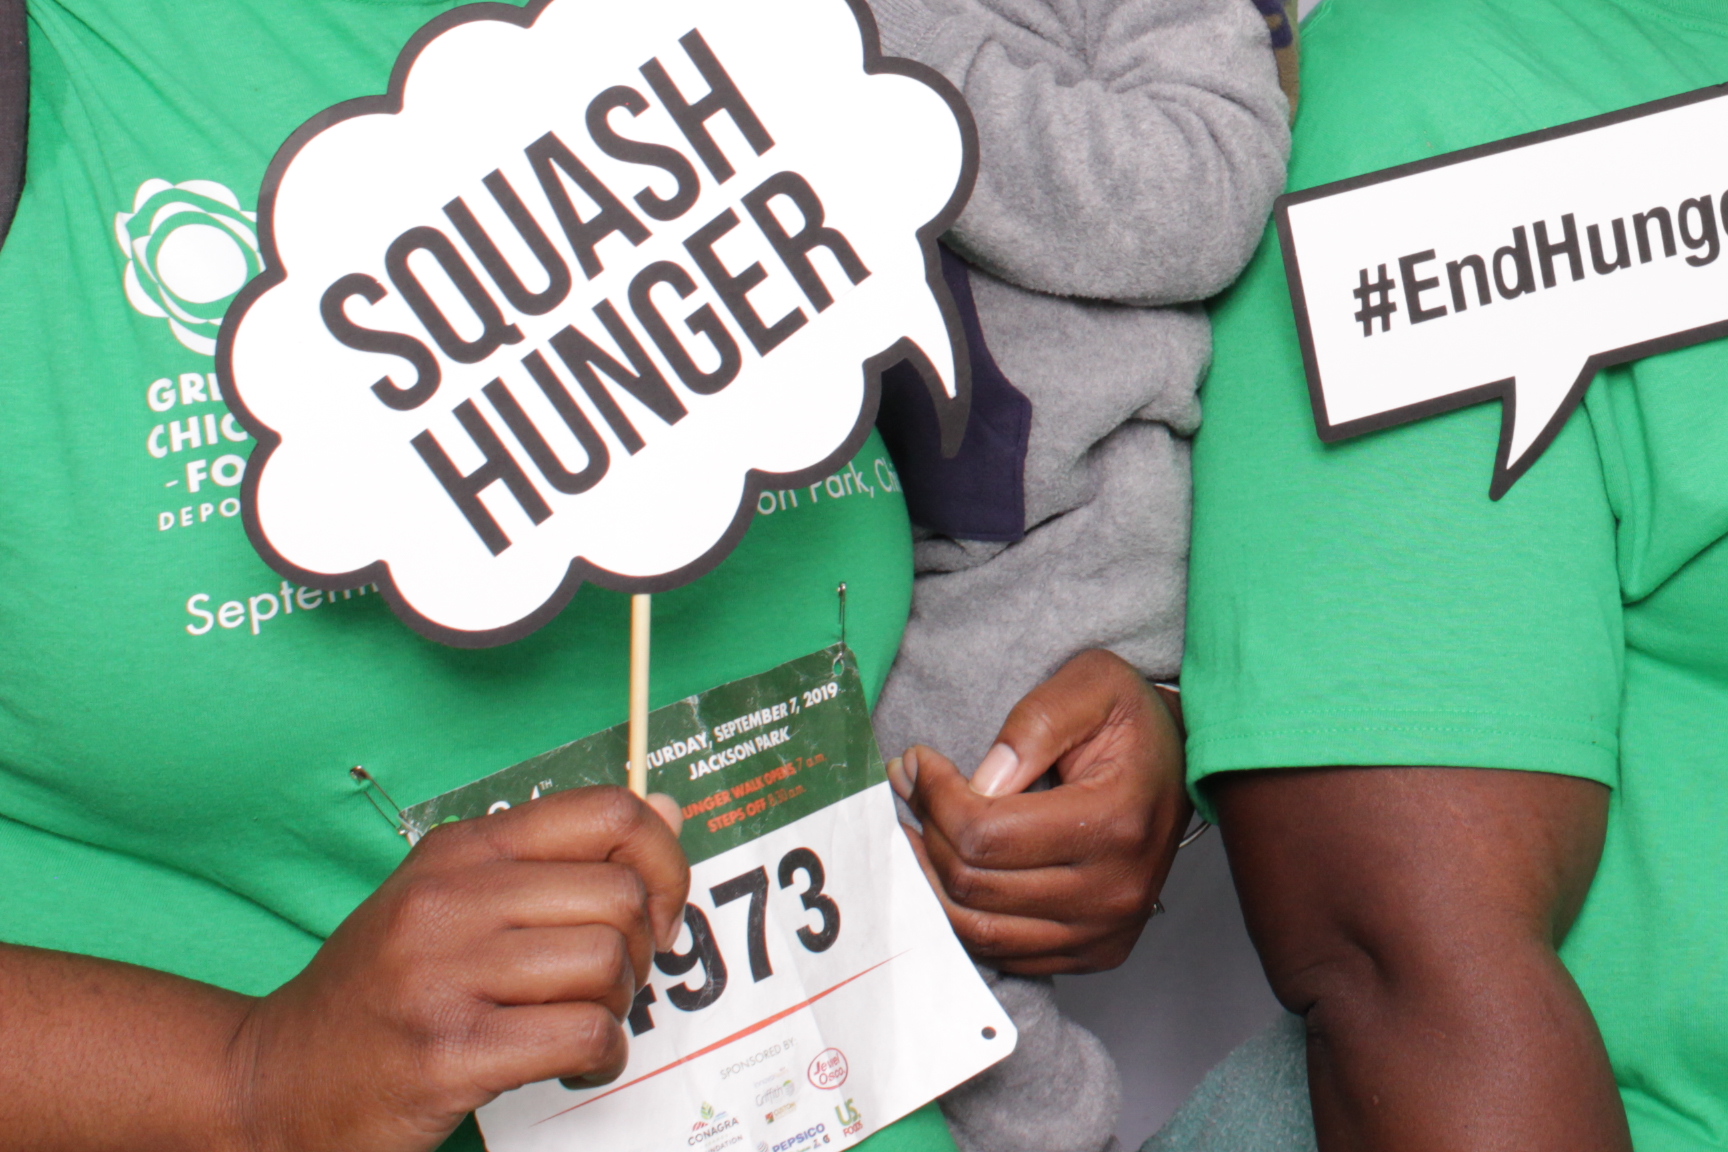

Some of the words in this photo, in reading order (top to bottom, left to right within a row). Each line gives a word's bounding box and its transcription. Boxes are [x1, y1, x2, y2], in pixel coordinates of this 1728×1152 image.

[319, 27, 776, 411] SQUASH
[409, 170, 873, 558] HUNGER
[147, 412, 249, 458] CHIC
[625, 732, 713, 771] TURDAY,
[714, 702, 789, 743] SEPTEMBER
[789, 696, 800, 715] 7,
[803, 682, 839, 708] 2019
[689, 740, 757, 781] JACKSON
[755, 725, 791, 753] PARK
[681, 790, 733, 820] UNGER
[731, 776, 766, 799] WALK
[763, 762, 797, 786] OPENS
[707, 807, 747, 834] STEPS
[745, 797, 767, 817] OFF
[720, 1044, 783, 1080] SPONSORED
[687, 1116, 740, 1147] CONAGRA
[771, 1122, 826, 1152] PEPSICO
